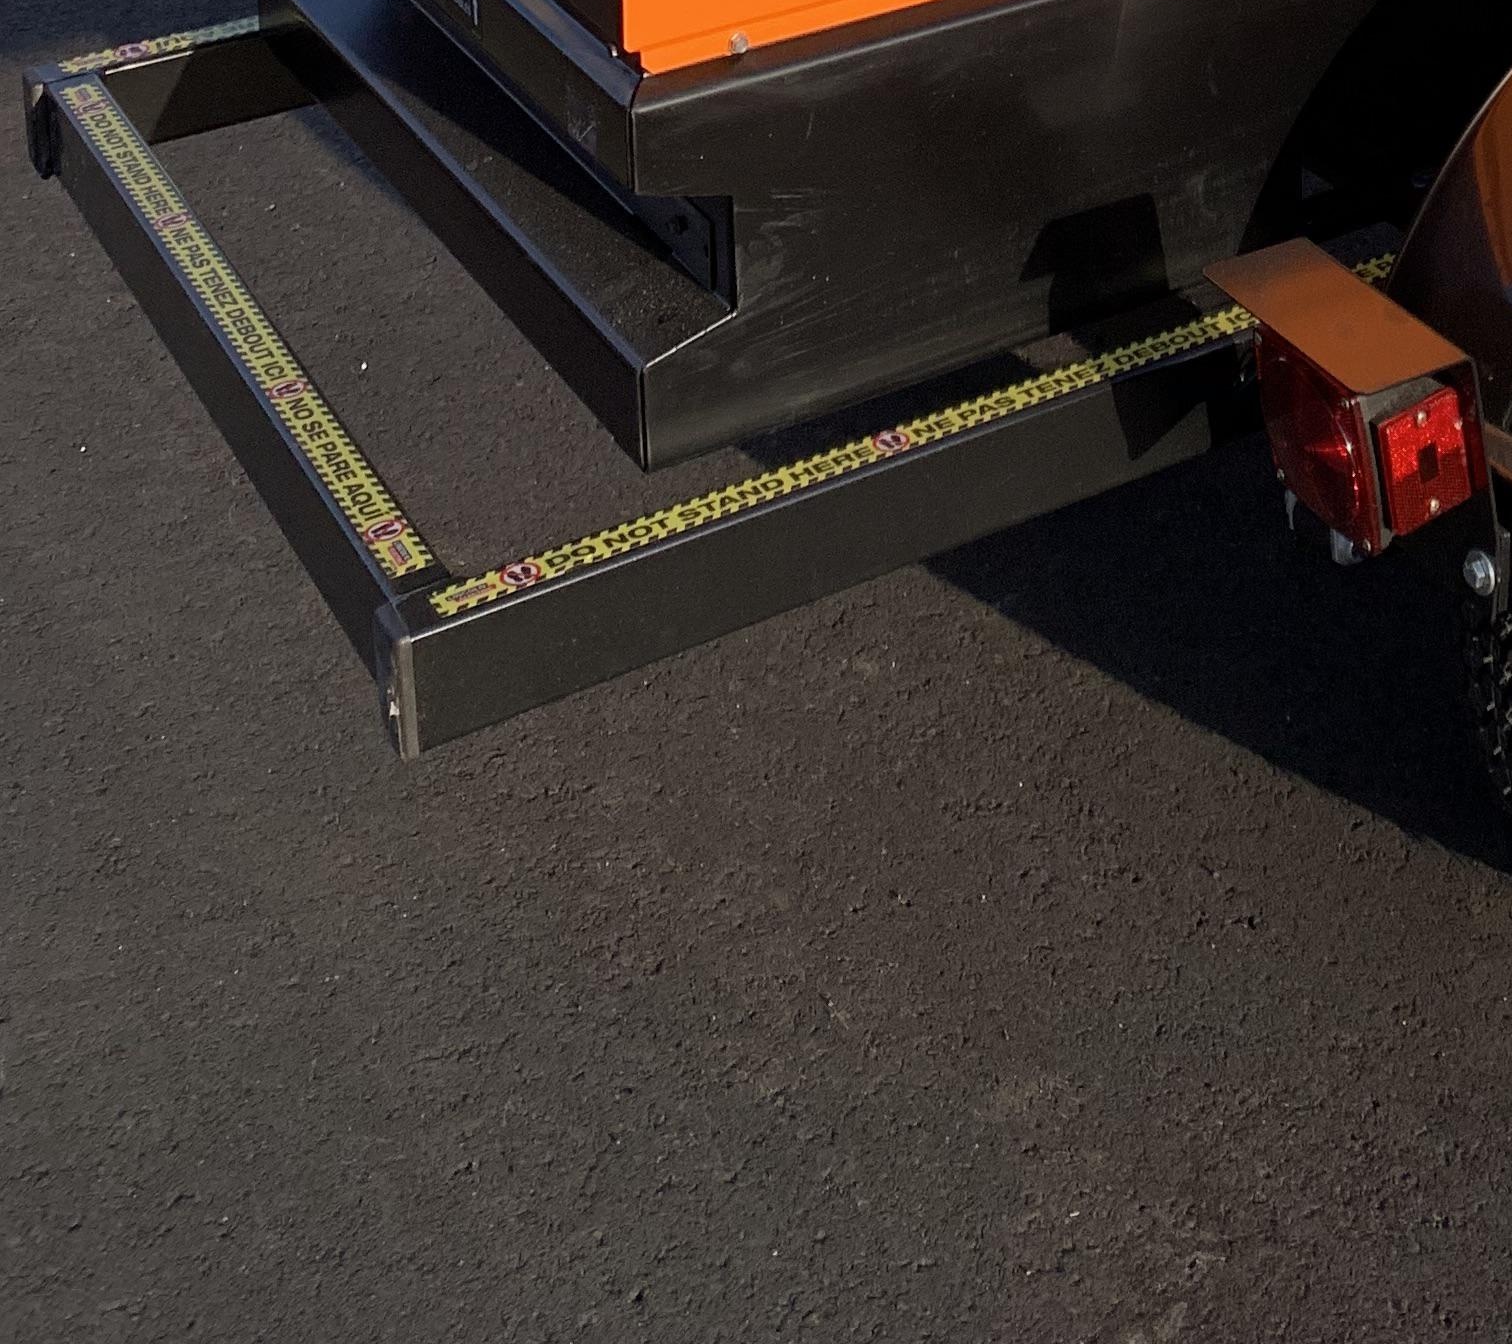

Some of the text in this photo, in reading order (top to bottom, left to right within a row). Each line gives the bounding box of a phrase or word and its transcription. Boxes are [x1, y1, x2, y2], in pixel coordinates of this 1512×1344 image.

[90, 112, 174, 216] DO NOT STAND HERE
[169, 227, 289, 382] NE PAS TENEZ DEBOUT ICI
[286, 396, 314, 421] NO
[302, 420, 330, 443] SE
[315, 441, 358, 483] PARE
[544, 544, 597, 568] DO
[603, 517, 671, 548] NOT
[677, 477, 785, 521] STAND
[789, 445, 873, 481] HERE
[909, 417, 956, 438] NE
[959, 395, 1017, 423] PAS
